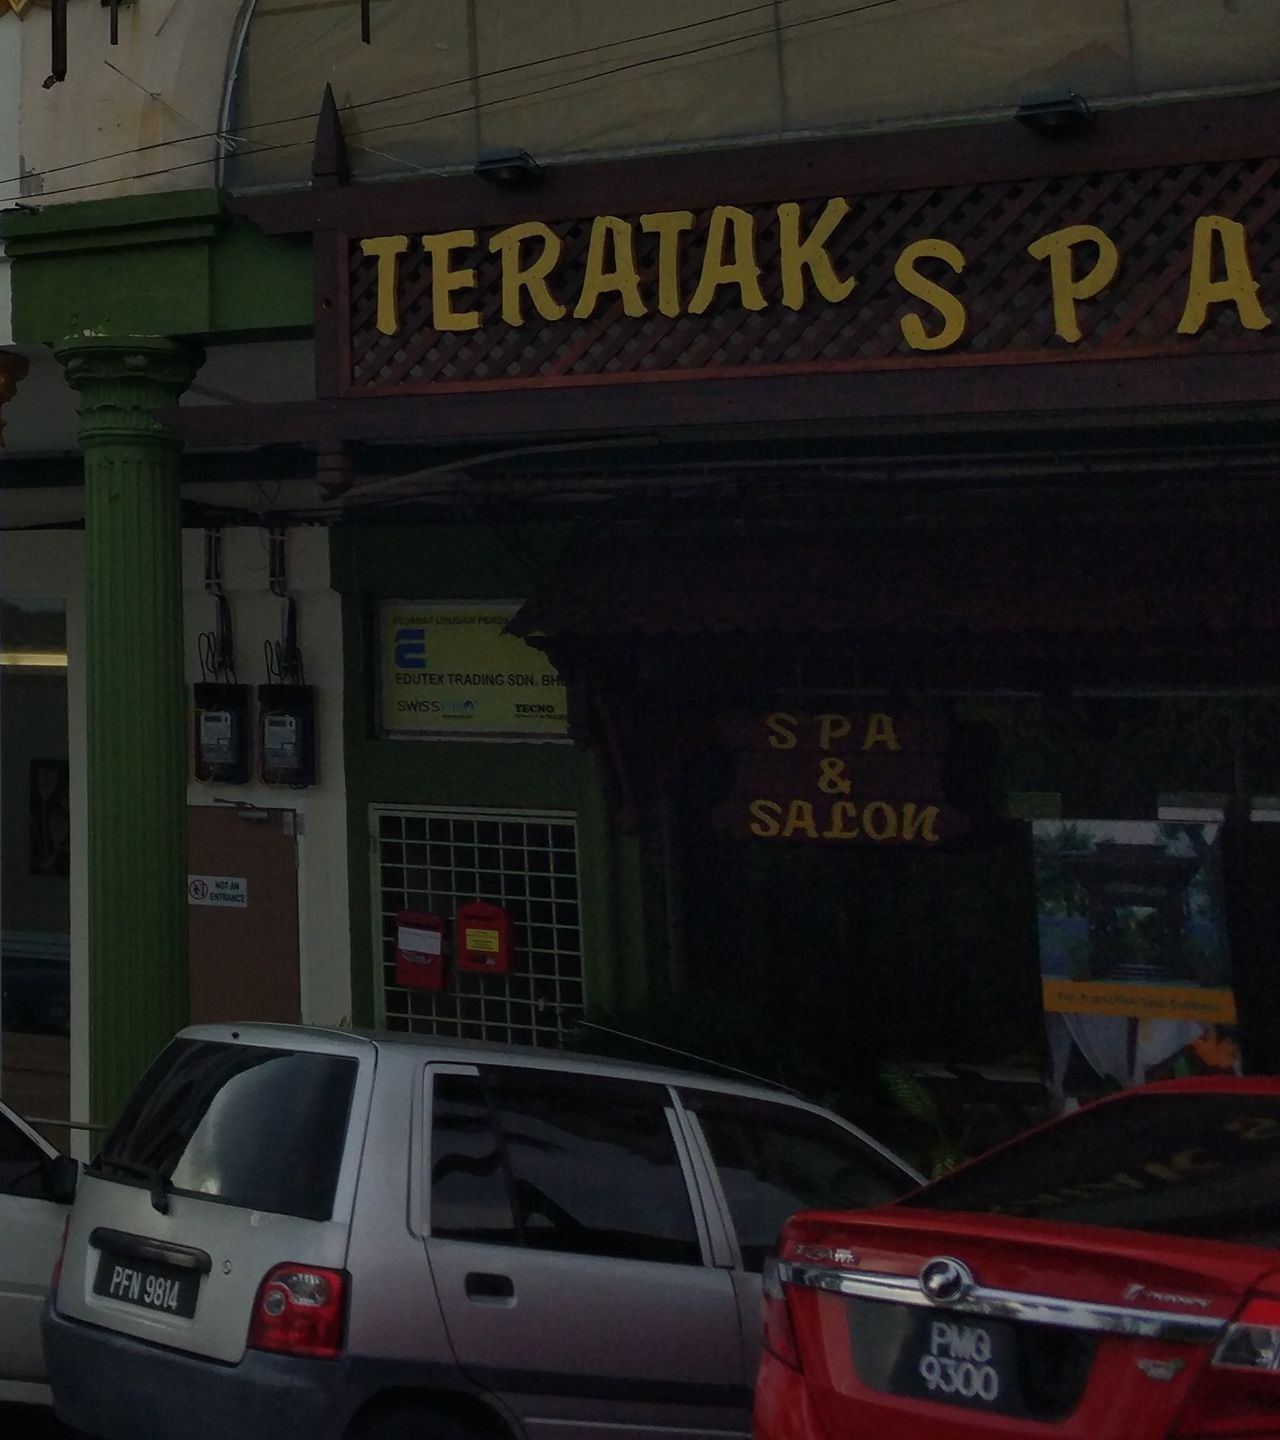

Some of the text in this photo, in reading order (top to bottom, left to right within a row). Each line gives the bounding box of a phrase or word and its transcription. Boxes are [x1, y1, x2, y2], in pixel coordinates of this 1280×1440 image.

[361, 197, 858, 336] TERATAK
[396, 672, 444, 686] EDUTEX
[448, 672, 504, 687] TRADING
[817, 757, 852, 796] &
[749, 799, 940, 842] SALON
[110, 1264, 180, 1310] PFN 9814
[919, 1355, 999, 1401] 9300
